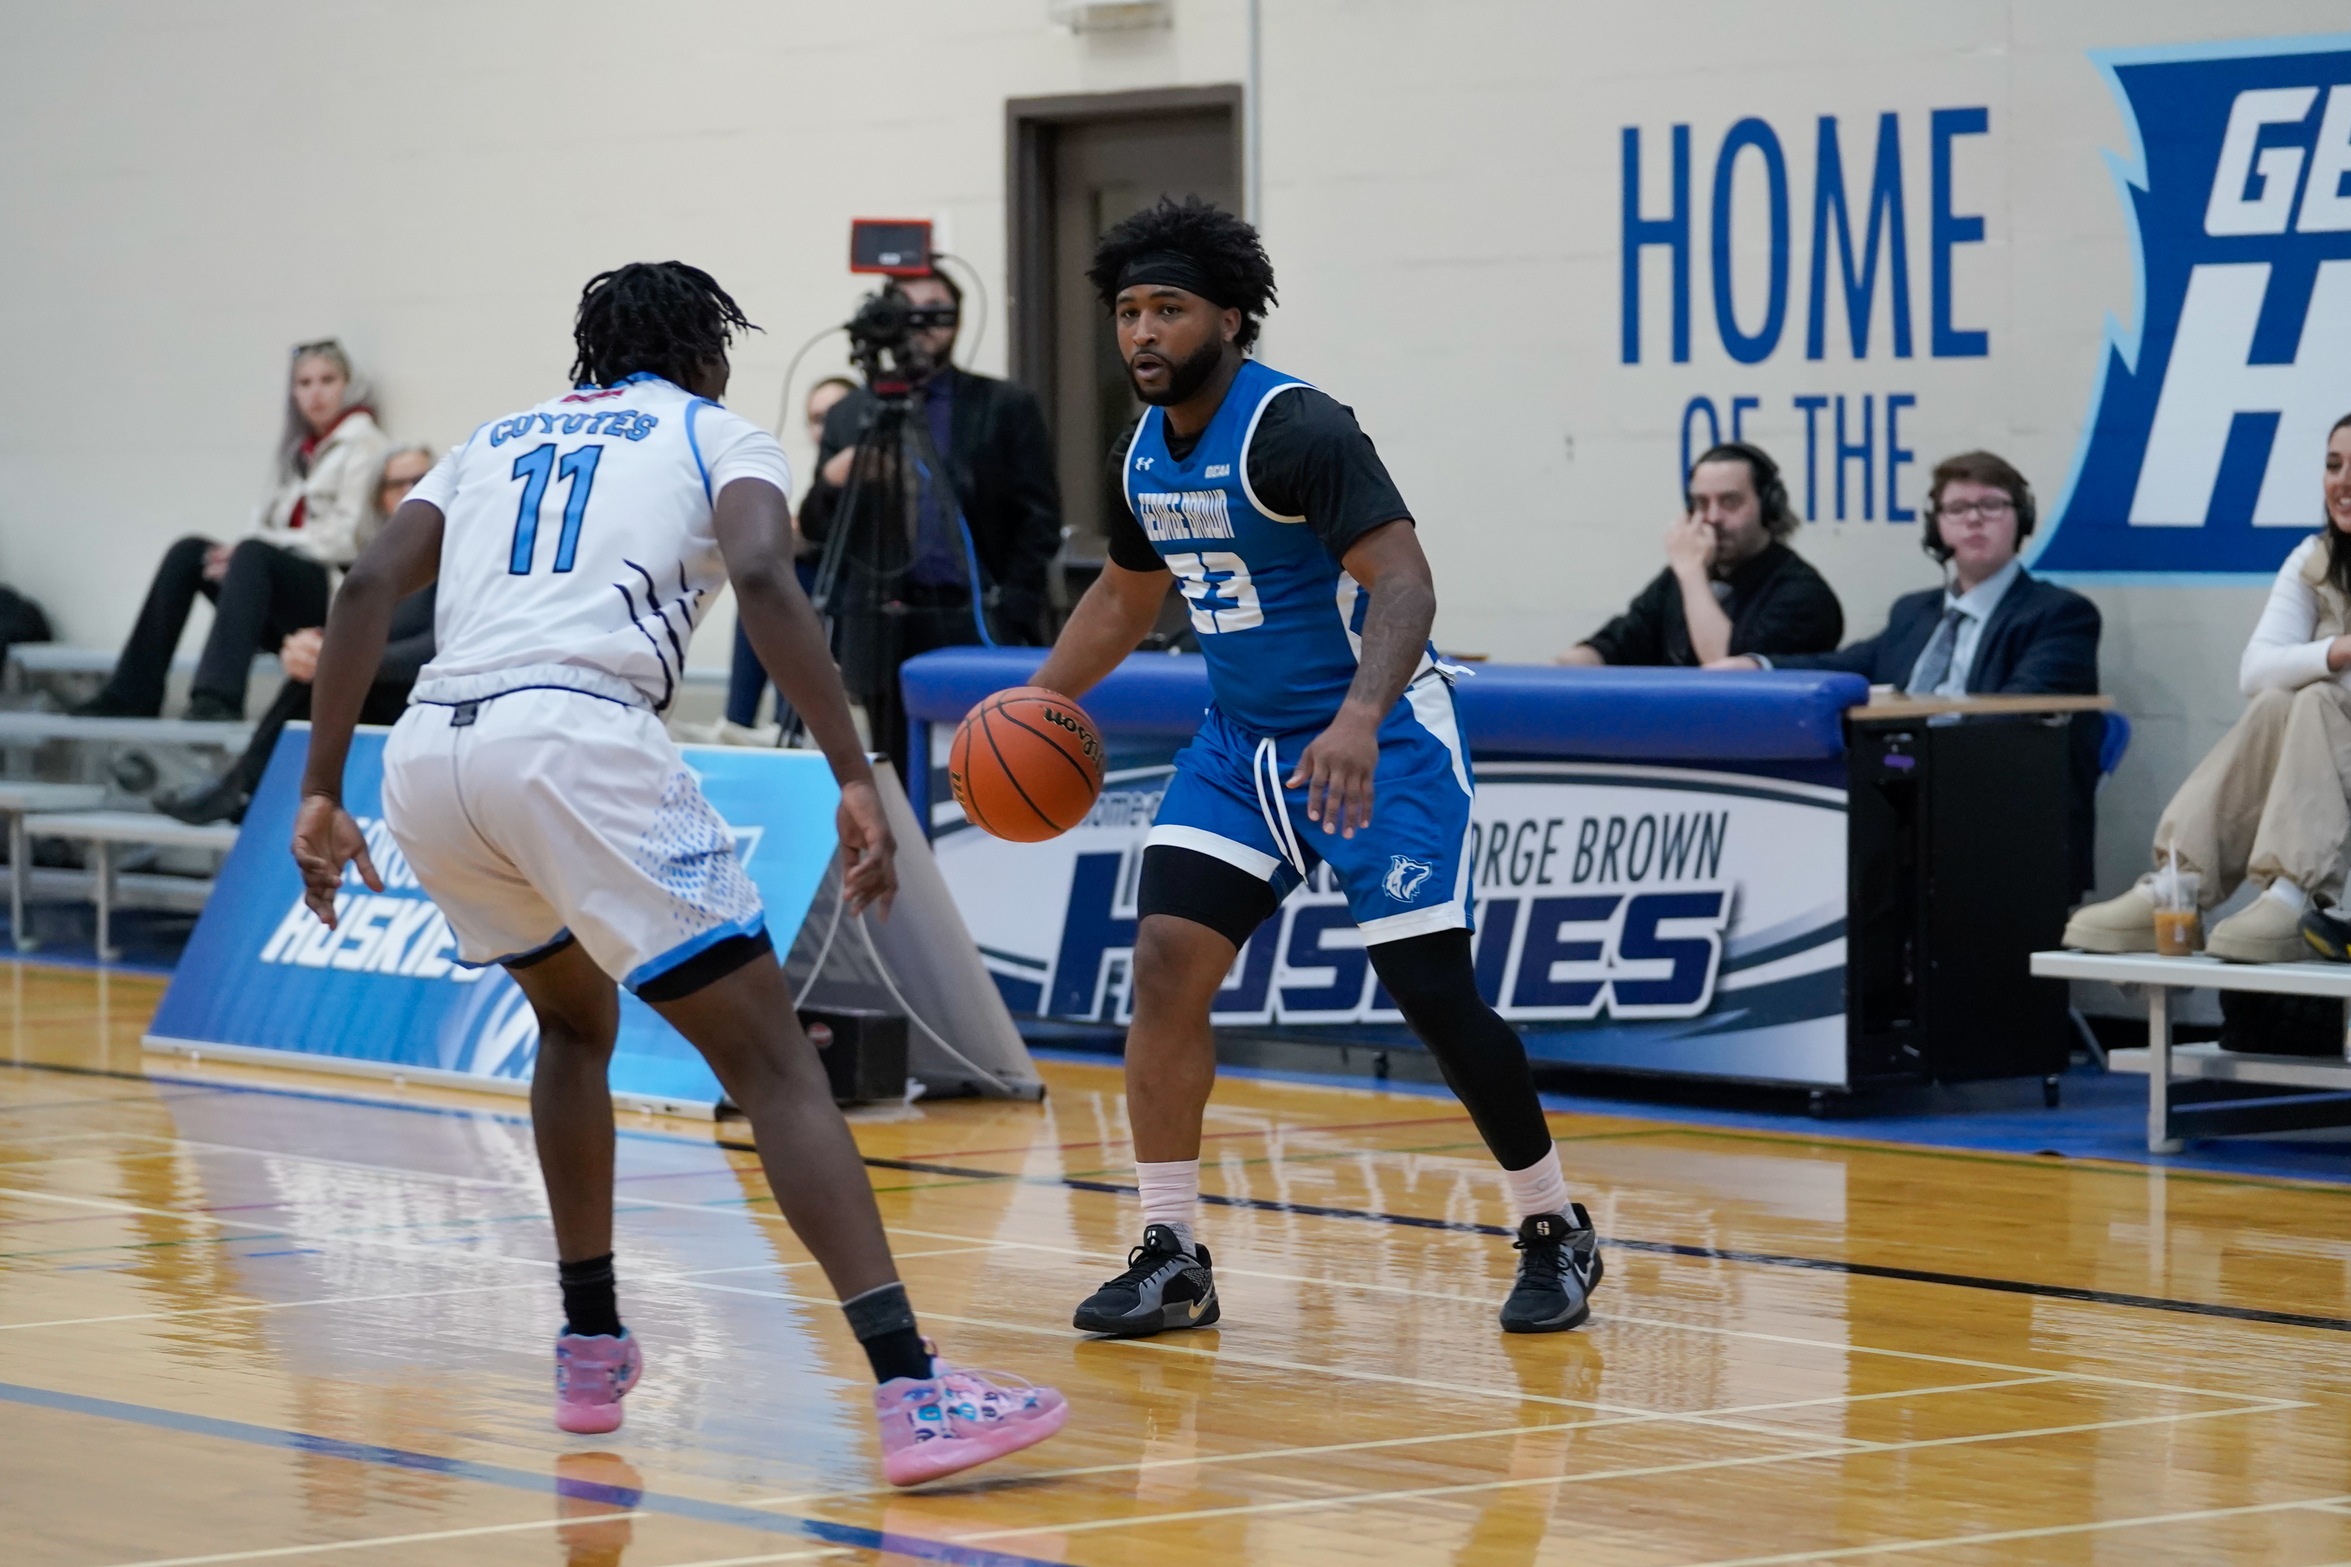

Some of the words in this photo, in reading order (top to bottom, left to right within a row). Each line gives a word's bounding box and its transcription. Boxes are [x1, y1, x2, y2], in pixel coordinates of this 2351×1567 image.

[1621, 107, 1989, 364] HOME
[490, 409, 659, 448] COYOTES
[1794, 394, 1917, 522] THE
[508, 442, 605, 576] 11
[1181, 488, 1235, 539] BROWN
[1164, 551, 1265, 635] 23
[1472, 816, 1564, 887] ORGE
[1571, 811, 1729, 884] BROWN
[259, 892, 488, 982] HUSKIE
[1043, 850, 1734, 1020] HUSIES
